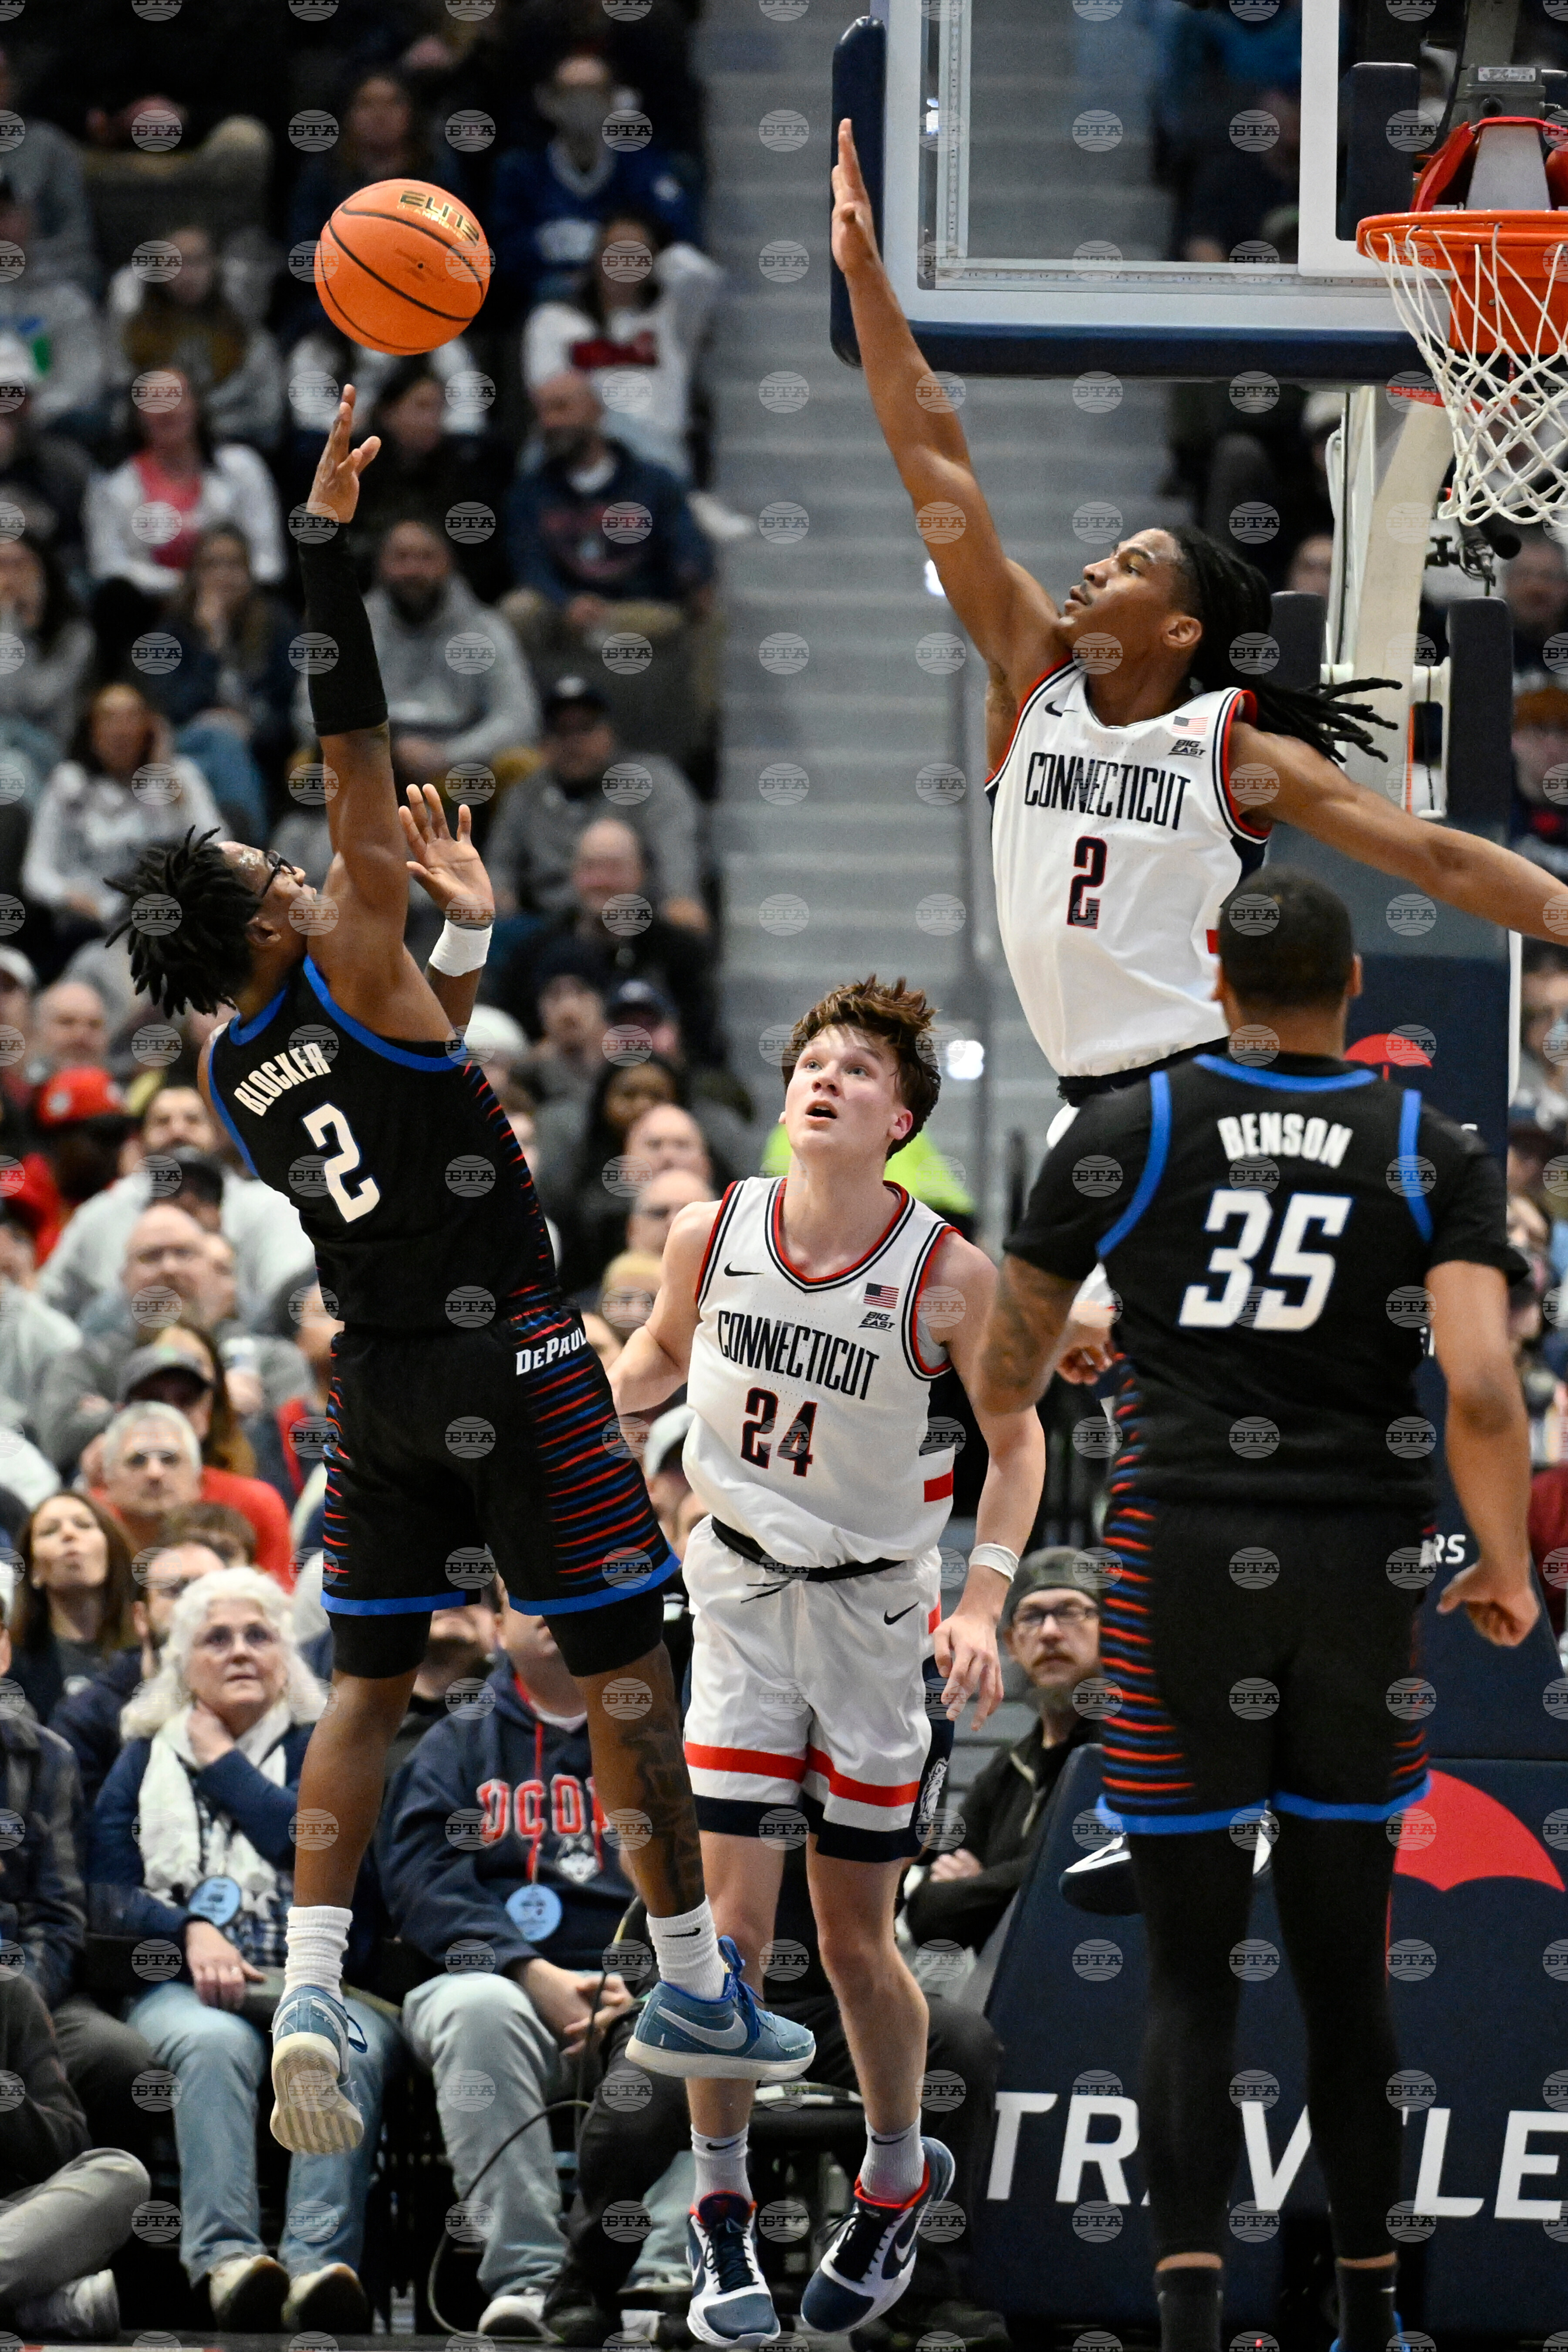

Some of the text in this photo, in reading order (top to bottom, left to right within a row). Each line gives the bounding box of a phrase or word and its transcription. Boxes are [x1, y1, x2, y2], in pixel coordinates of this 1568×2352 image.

[400, 190, 479, 247] ELITE
[1171, 746, 1206, 756] EAST
[1176, 739, 1201, 747] BIG
[1024, 752, 1190, 830] CONNECTICUT
[1067, 836, 1107, 929] 2
[233, 1043, 331, 1116] BLOCKER
[301, 1101, 381, 1223] 2
[1217, 1112, 1353, 1169] BENSON
[1178, 1188, 1353, 1331] 35
[861, 1318, 896, 1328] EAST
[866, 1311, 891, 1321] BIG
[718, 1310, 879, 1400] CONNECTICUT
[740, 1387, 818, 1477] 24
